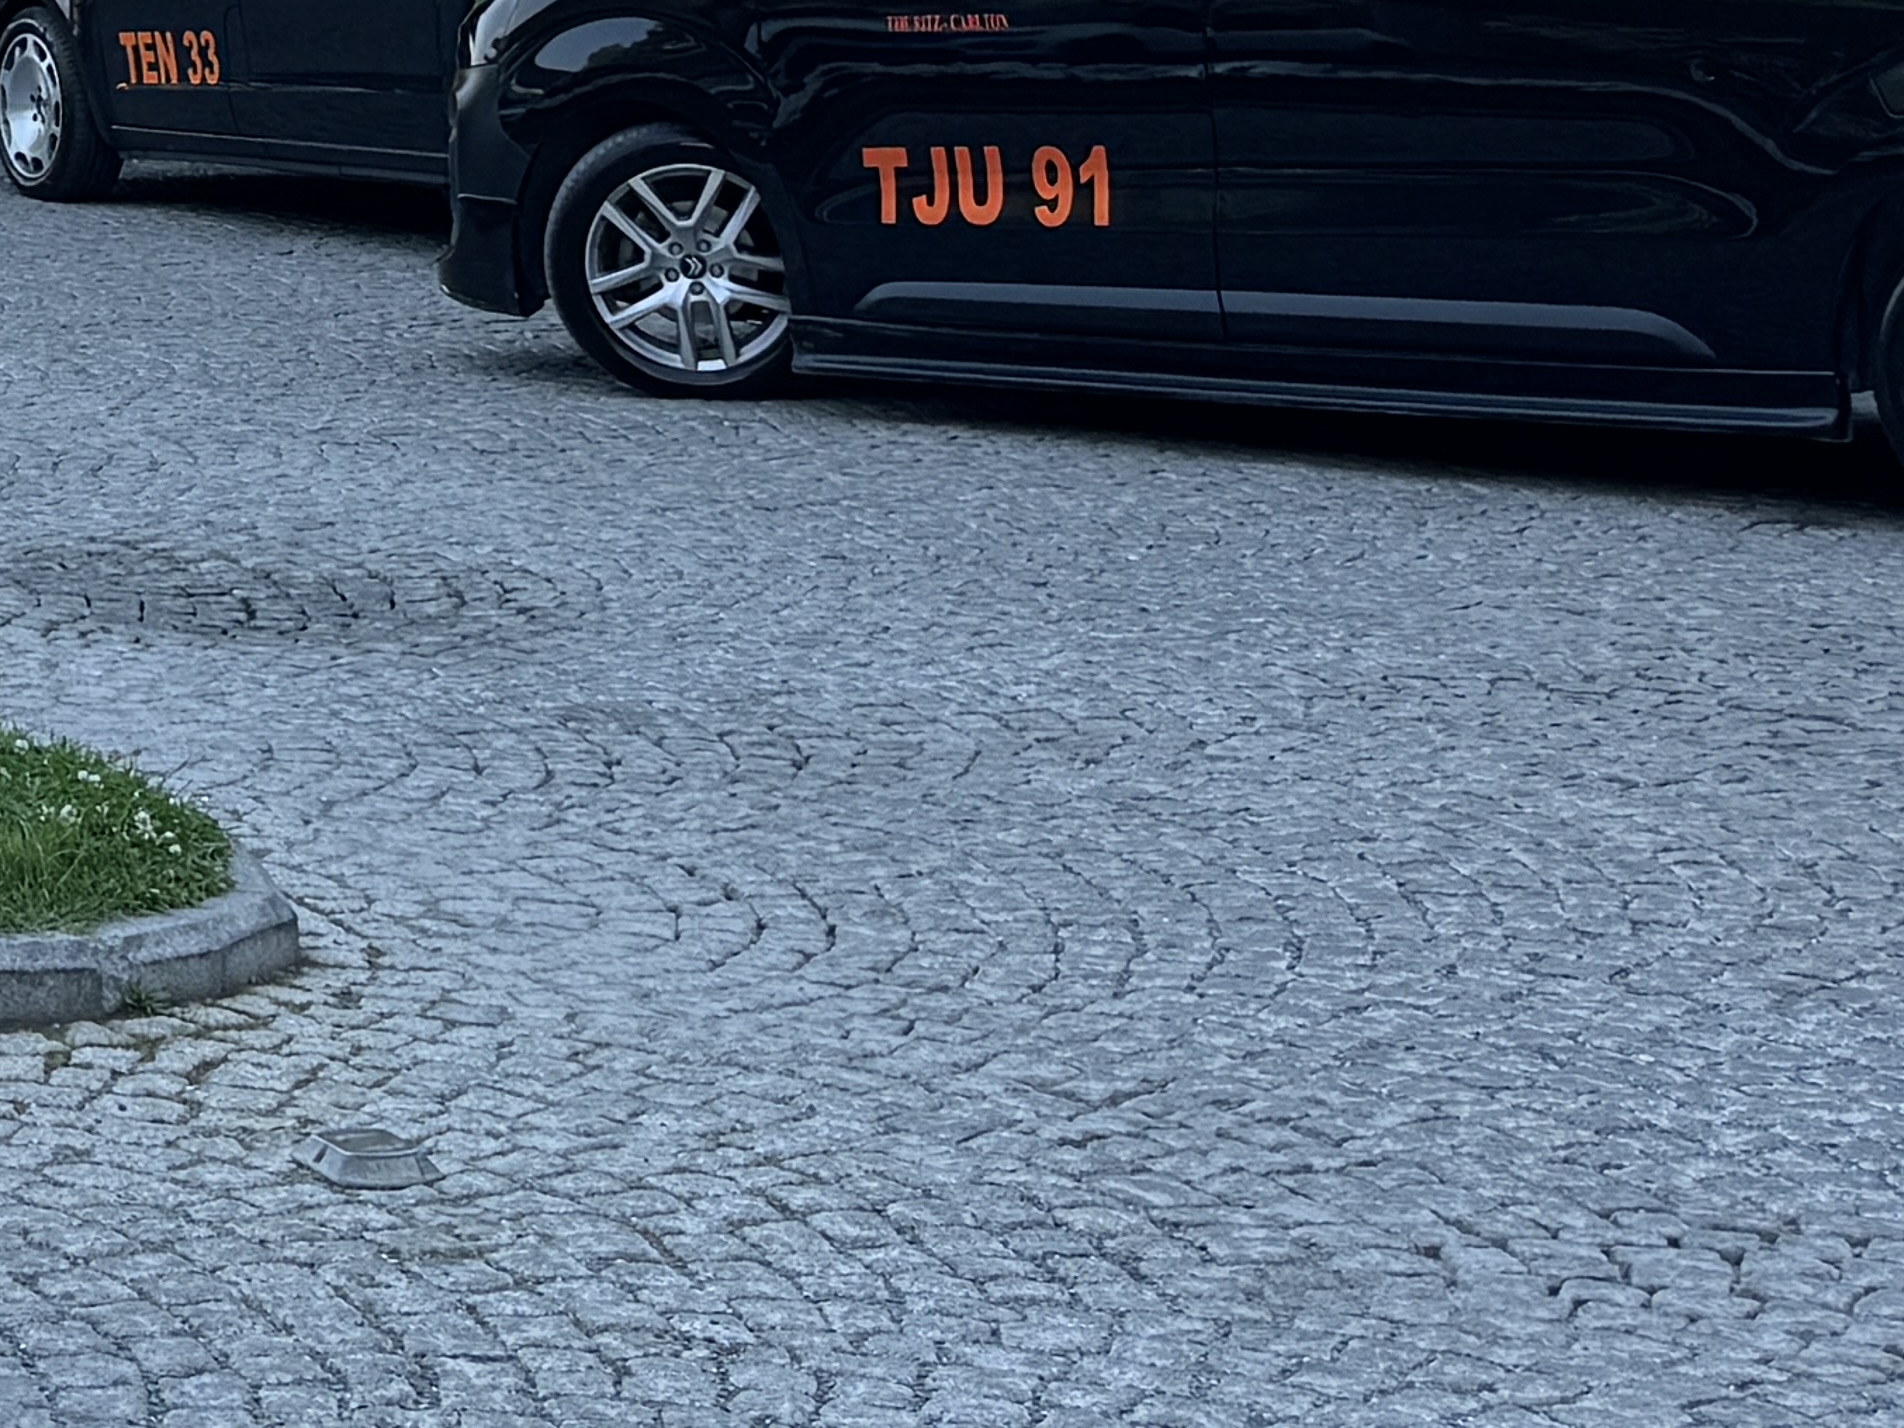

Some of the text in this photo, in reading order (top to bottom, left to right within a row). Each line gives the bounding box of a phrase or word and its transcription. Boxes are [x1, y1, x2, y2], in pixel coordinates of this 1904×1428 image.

[118, 30, 220, 85] TEN 33
[861, 145, 1110, 228] TJU 91
